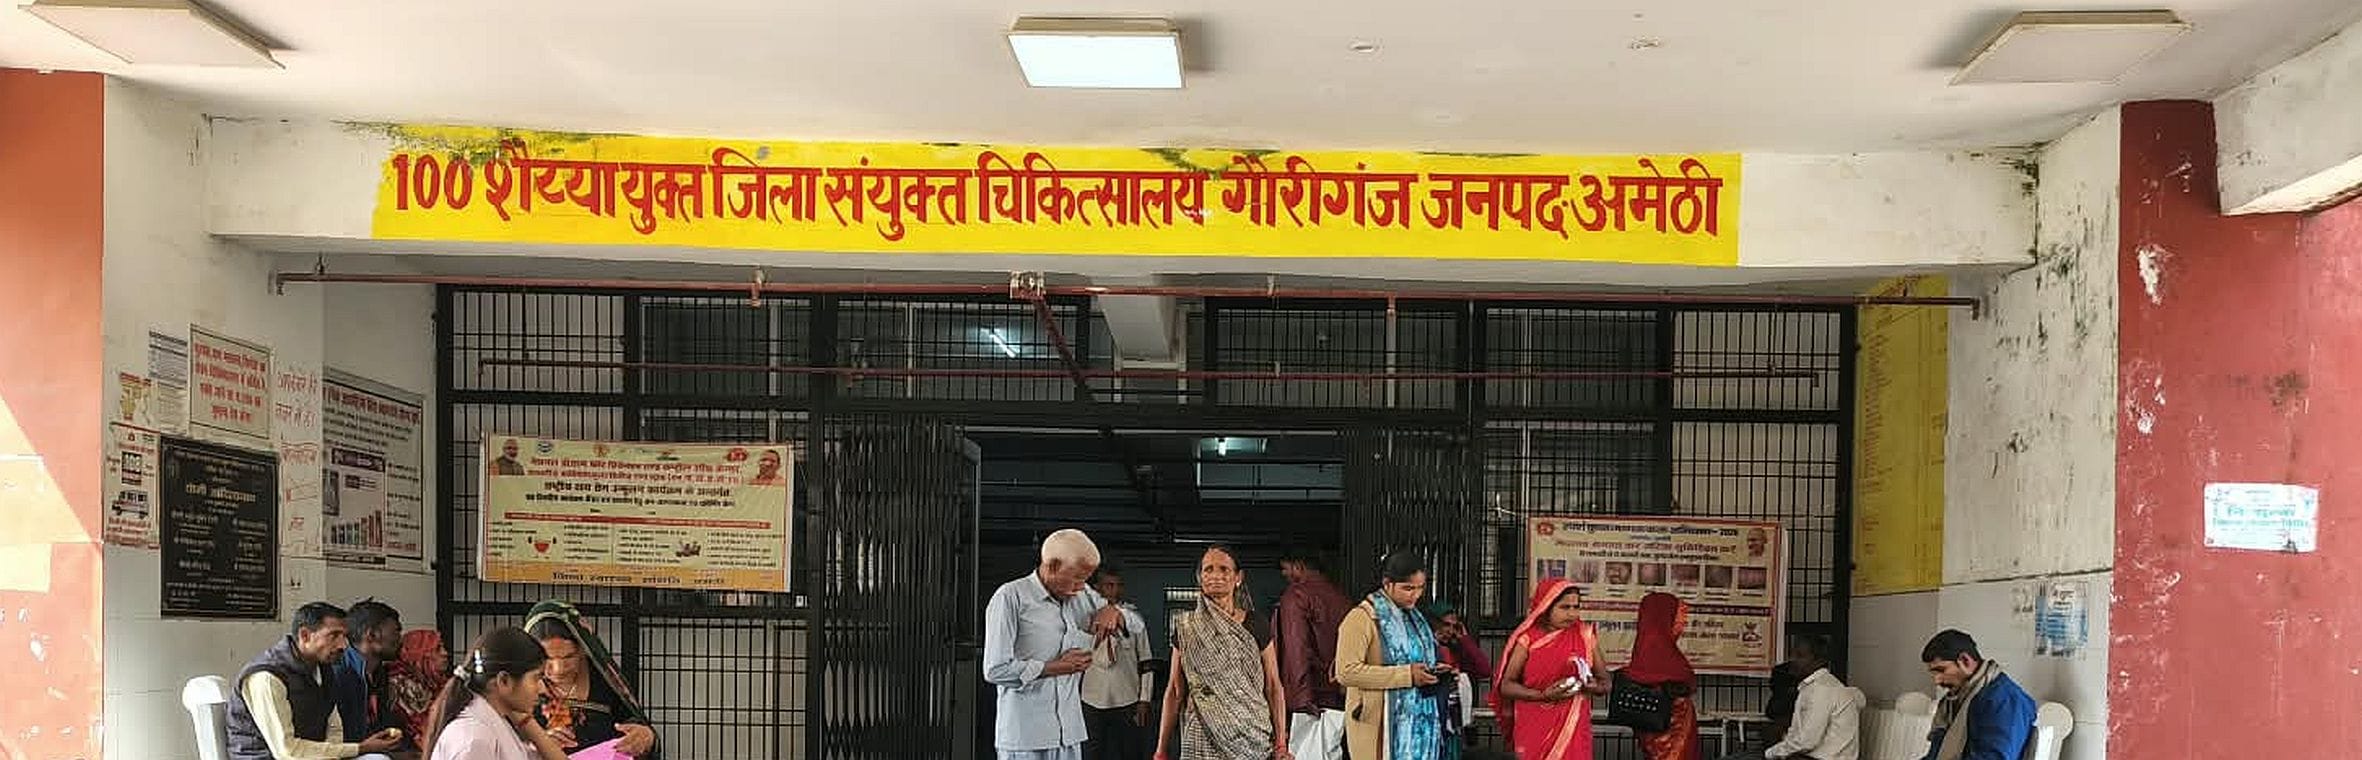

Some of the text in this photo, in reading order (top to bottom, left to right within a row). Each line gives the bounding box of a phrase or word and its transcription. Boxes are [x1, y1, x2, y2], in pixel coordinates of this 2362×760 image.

[392, 154, 473, 210] 100
[618, 162, 707, 235] युक्त
[708, 147, 823, 224] जिला
[823, 157, 973, 241] संयुक्त
[974, 151, 1211, 228] चिकित्सालय
[1219, 154, 1419, 229] गौरीगंज
